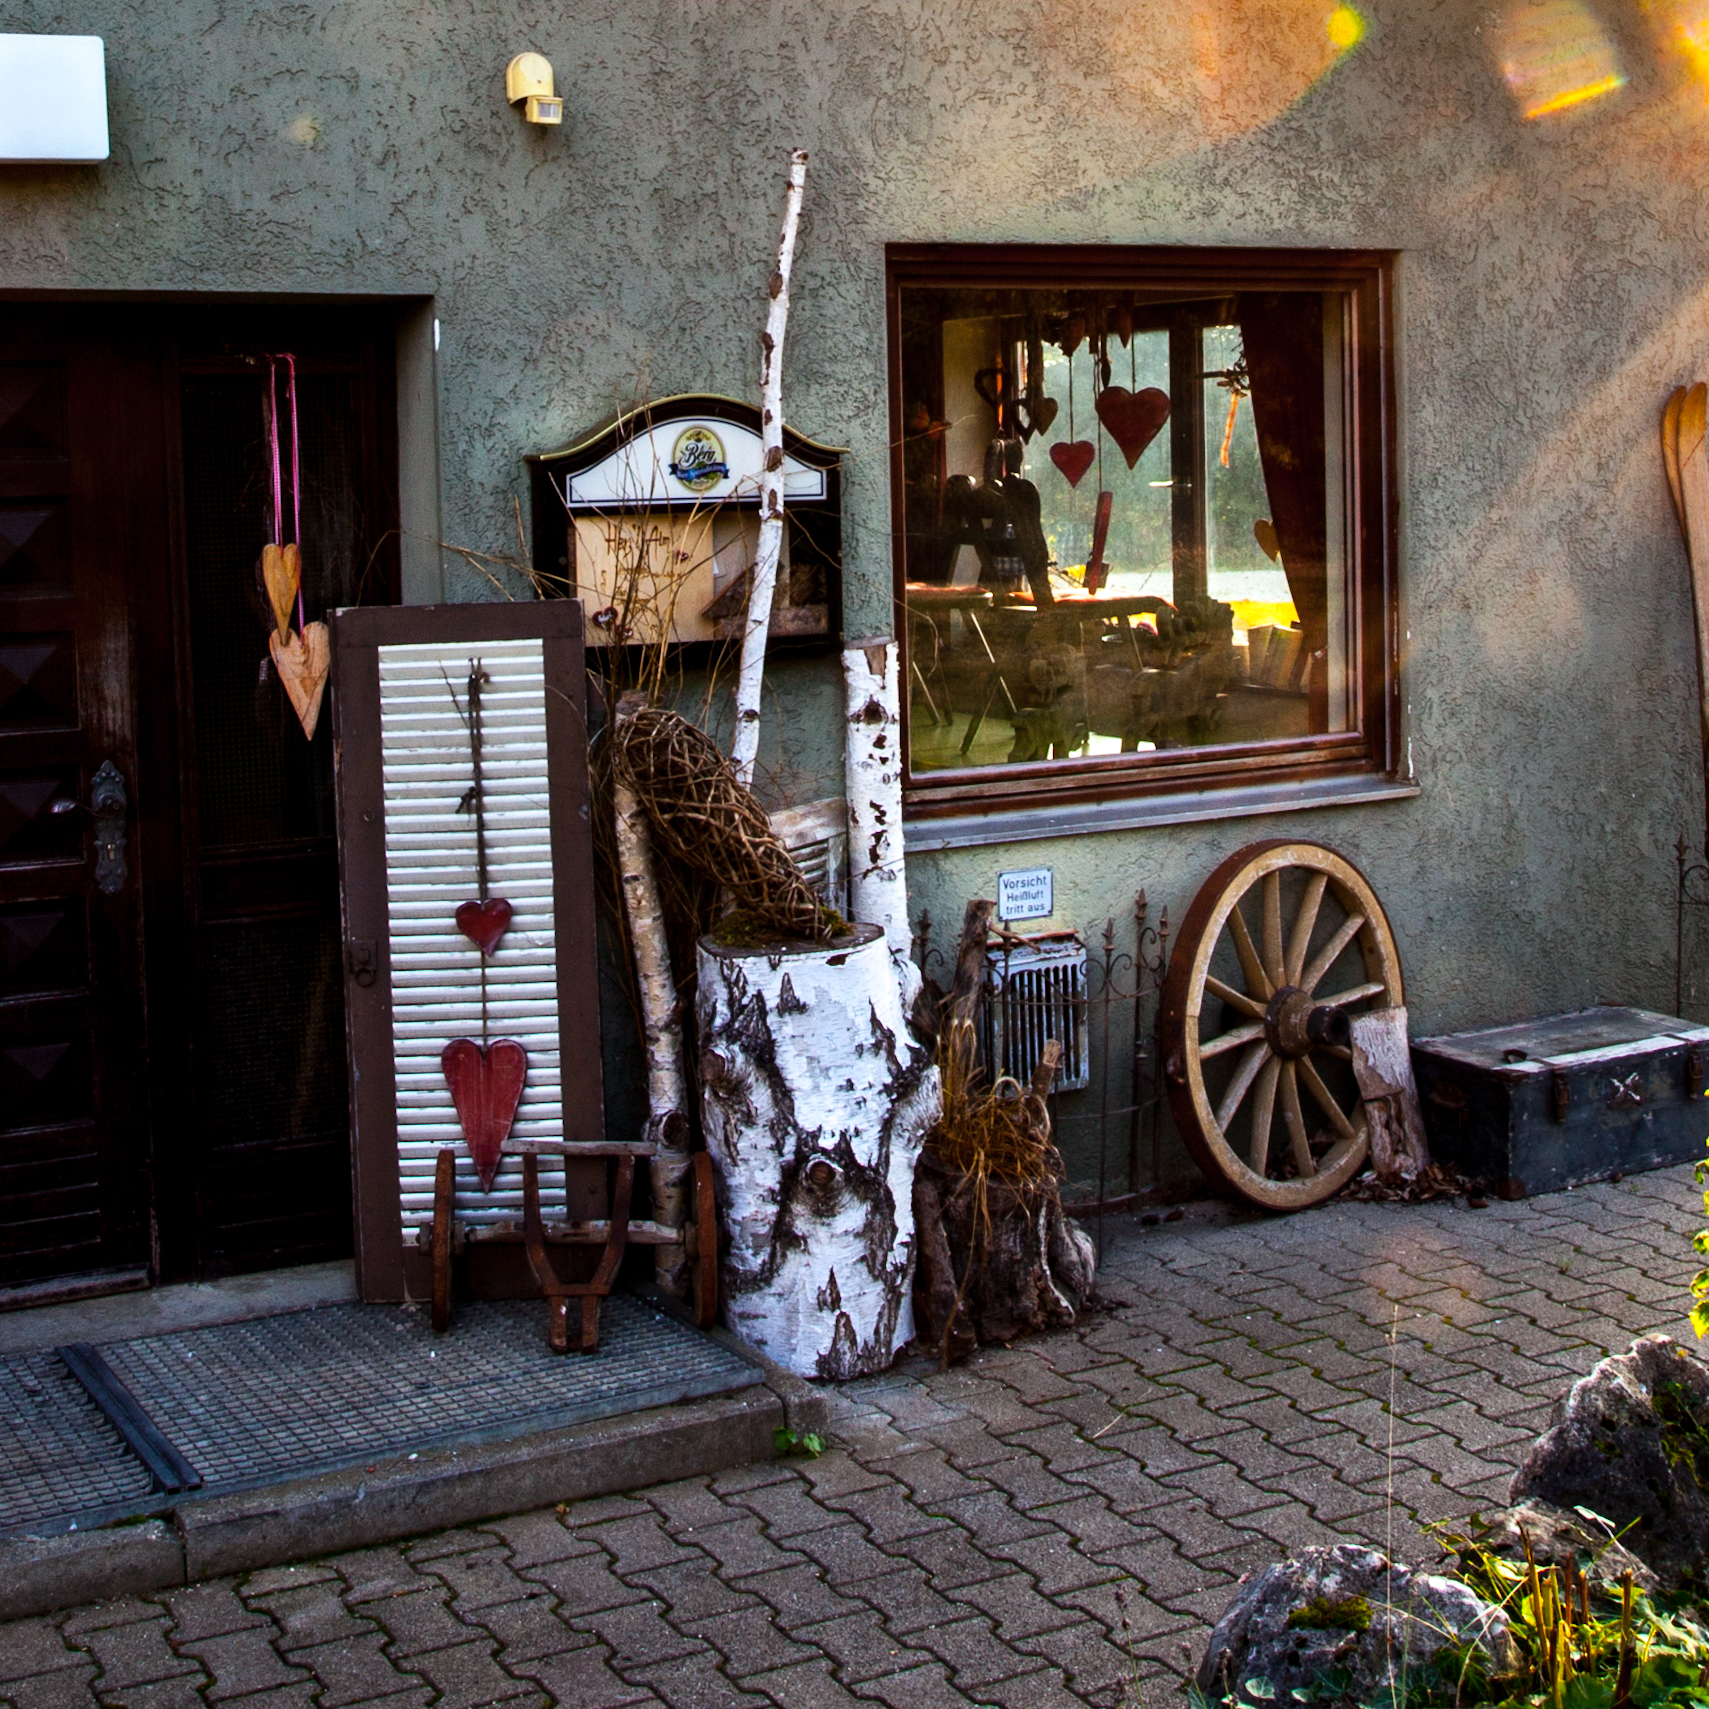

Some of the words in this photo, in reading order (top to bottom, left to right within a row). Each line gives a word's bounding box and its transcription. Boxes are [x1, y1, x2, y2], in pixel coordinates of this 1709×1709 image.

[1003, 875, 1047, 889] Vorsicht
[1007, 890, 1044, 902] Heißluft
[1006, 904, 1024, 914] tritt
[1028, 903, 1045, 912] aus
